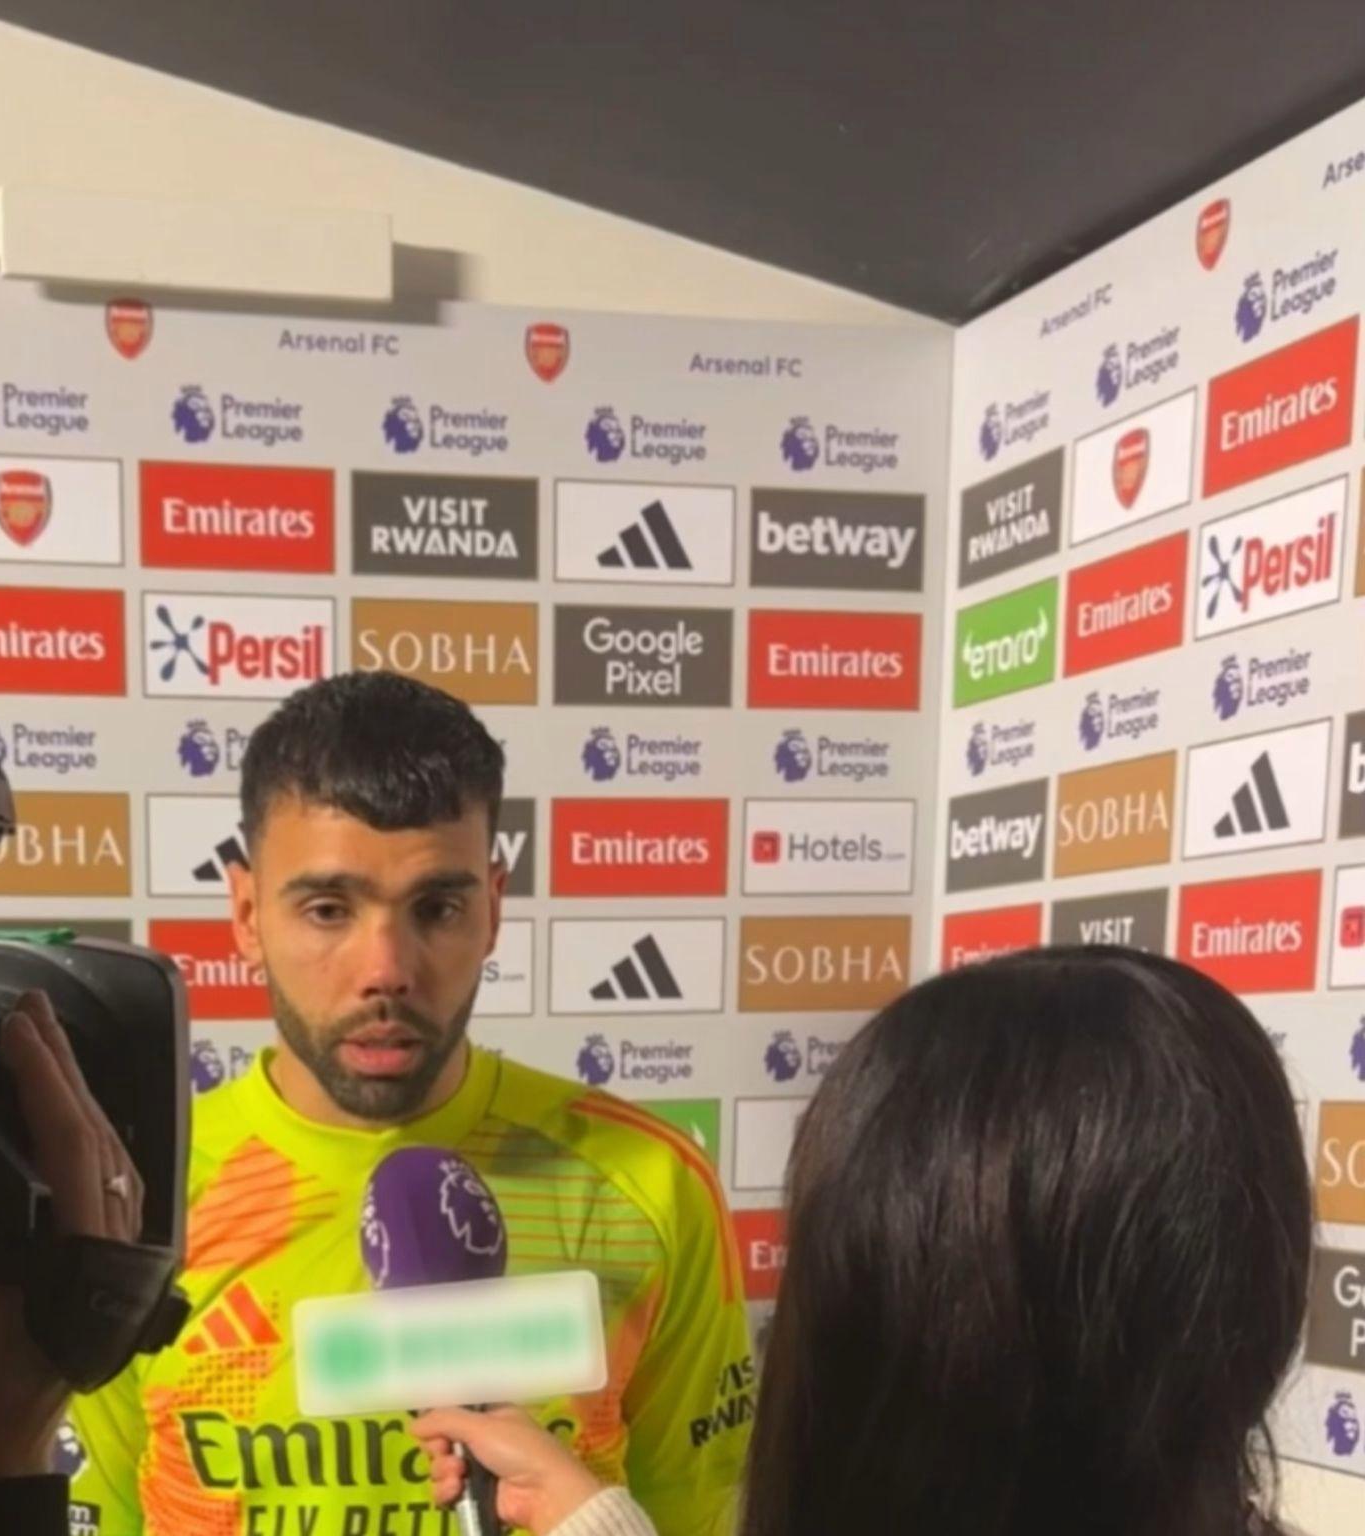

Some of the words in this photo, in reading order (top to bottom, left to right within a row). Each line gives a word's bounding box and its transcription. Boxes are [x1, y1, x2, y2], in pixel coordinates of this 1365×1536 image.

[1271, 249, 1339, 290] Premier
[1039, 297, 1091, 338] Arsenal
[1094, 283, 1113, 307] FC
[1270, 278, 1337, 322] League
[279, 329, 366, 355] Arsenal
[371, 335, 400, 356] FC
[1126, 326, 1180, 361] Premier
[689, 353, 770, 377] Arsenal
[776, 358, 803, 378] FC
[1125, 352, 1180, 390] League
[2, 383, 89, 410] Premier
[221, 394, 303, 421] Premier
[3, 407, 89, 437] League
[429, 405, 508, 431] Premier
[631, 416, 706, 441] Premier
[1220, 376, 1338, 451] Emirates
[221, 418, 303, 447] League
[429, 428, 509, 457] League
[824, 425, 898, 450] Premier
[631, 438, 707, 467] League
[824, 446, 898, 474] League
[161, 497, 315, 540] Emirates
[402, 495, 489, 526] VISIT
[985, 484, 1034, 526] VISIT
[370, 525, 519, 560] RWANDA
[757, 512, 917, 569] betway
[968, 510, 1050, 563] RWANDA
[1243, 512, 1338, 613] Persil
[1077, 581, 1173, 639] Emirates
[207, 621, 325, 685] Persil
[358, 628, 532, 675] SOBHA
[583, 617, 704, 664] Google
[605, 658, 682, 697] Pixel
[767, 643, 903, 680] Emirates
[1248, 648, 1311, 680] Premier
[1108, 688, 1160, 716] Premier
[1247, 674, 1311, 708] League
[13, 723, 97, 748] Premier
[1108, 711, 1158, 741] League
[14, 745, 98, 774] League
[626, 734, 702, 757] Premier
[817, 736, 889, 759] Premier
[626, 755, 702, 783] League
[817, 755, 889, 783] League
[1058, 790, 1168, 847] SOBHA
[570, 831, 709, 866] Emirates
[950, 812, 1042, 860] betway
[1079, 916, 1135, 944] VISIT
[1190, 917, 1302, 960] Emirates
[745, 946, 904, 984] SOBHA
[620, 1040, 693, 1062] Premier
[620, 1058, 693, 1085] League
